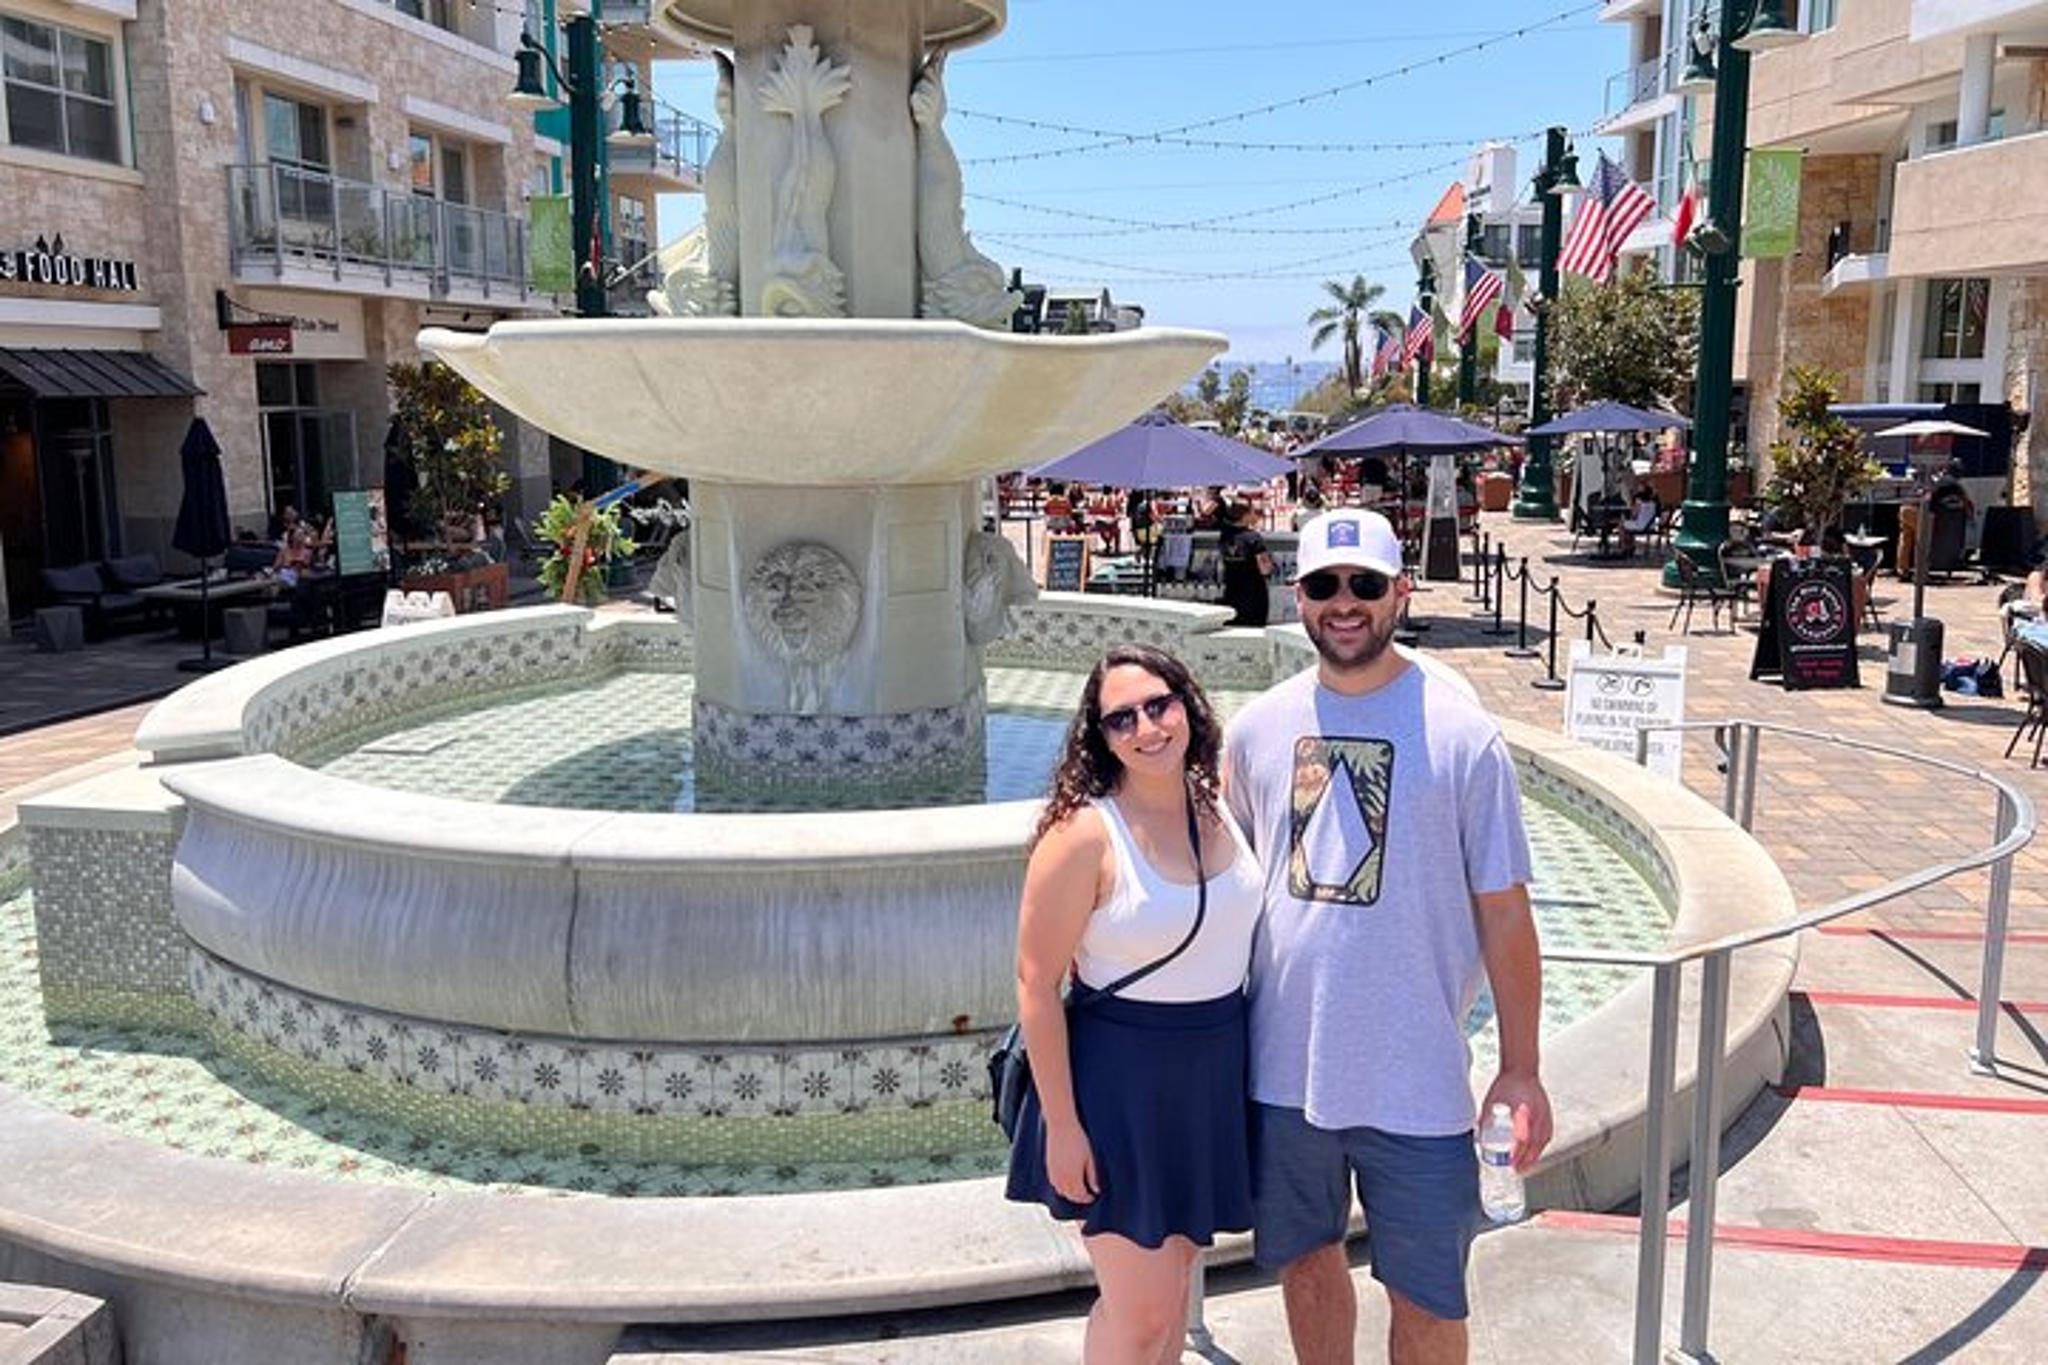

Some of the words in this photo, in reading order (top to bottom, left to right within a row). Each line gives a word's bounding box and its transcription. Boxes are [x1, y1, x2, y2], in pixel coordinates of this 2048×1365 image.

[25, 252, 86, 285] FOOD
[93, 258, 140, 291] HALL
[1604, 699, 1645, 713] SWIMMING
